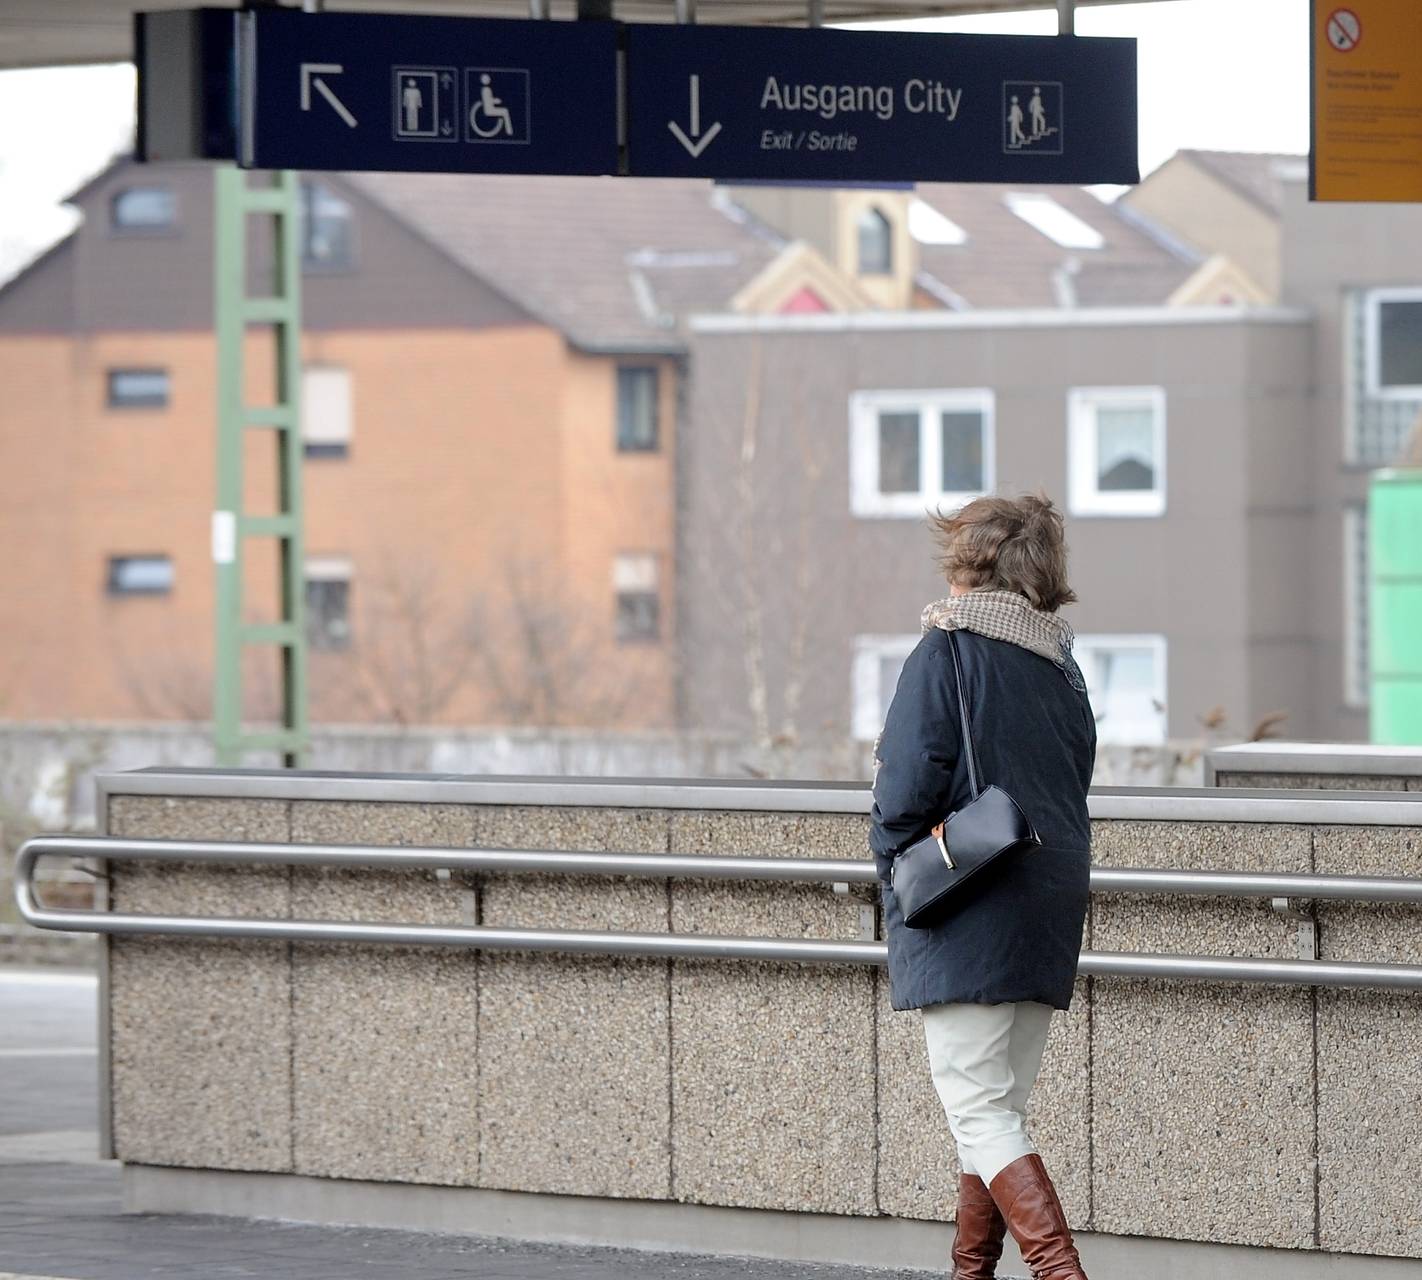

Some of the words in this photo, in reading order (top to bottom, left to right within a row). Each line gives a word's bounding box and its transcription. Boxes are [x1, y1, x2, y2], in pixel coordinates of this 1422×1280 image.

[760, 75, 894, 120] Ausgang
[903, 78, 963, 121] City
[759, 130, 793, 150] Exit
[807, 130, 858, 152] Sortie
